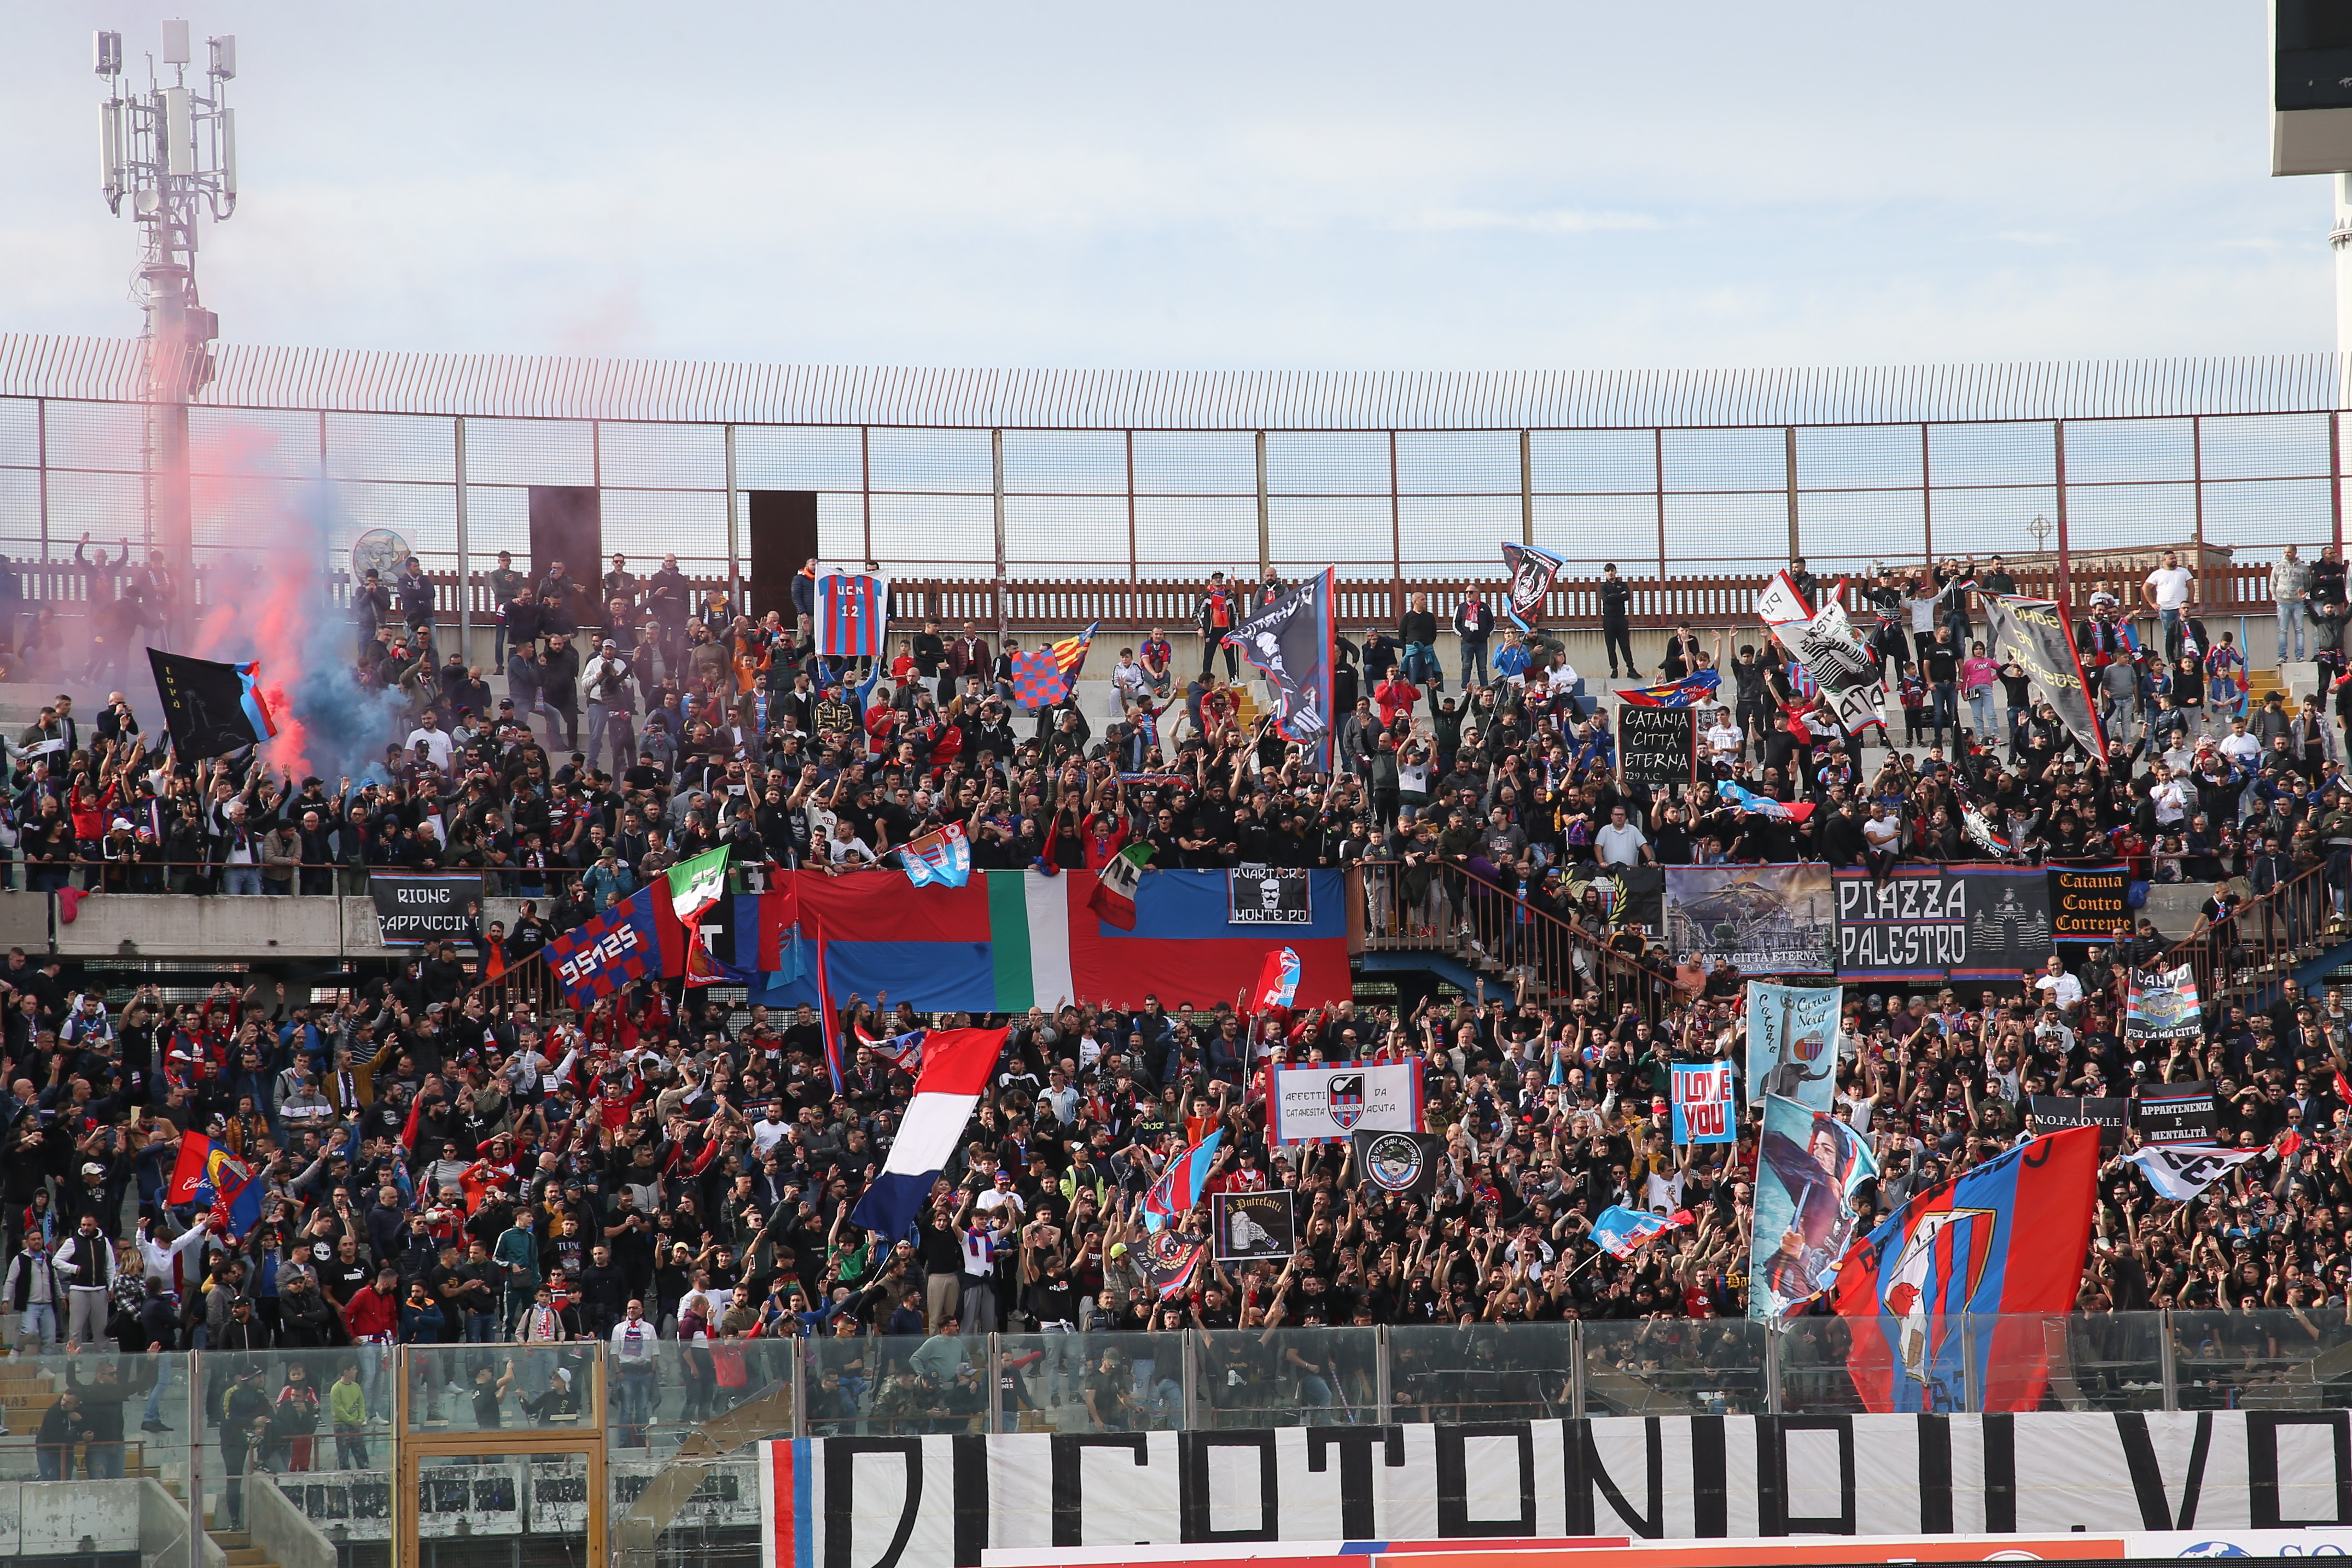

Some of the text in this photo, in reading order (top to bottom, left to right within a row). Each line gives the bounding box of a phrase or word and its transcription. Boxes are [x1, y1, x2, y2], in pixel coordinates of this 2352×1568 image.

[841, 605, 859, 617] 12
[1973, 662, 1989, 671] Cool
[1625, 710, 1689, 730] CATANIA
[1625, 753, 1689, 772] ETERNA
[1625, 772, 1640, 780] 729
[1643, 773, 1663, 781] A.C.
[1966, 800, 1999, 833] PIAZZA
[2060, 873, 2123, 888] Catania
[397, 889, 451, 904] RIONE
[1839, 878, 1966, 920] PIAZZA
[2063, 894, 2122, 911] Contro
[1235, 909, 1307, 922] MONTE PO
[2056, 914, 2132, 931] Corrente
[1841, 925, 1966, 966] PALESTRO
[558, 923, 639, 987] 95125
[1733, 950, 1769, 963] CITTÀ
[1772, 951, 1818, 962] ETERNA
[2137, 965, 2188, 987] CANTO
[1797, 992, 1832, 1013] Curva
[1759, 994, 1778, 1054] Catania
[1797, 1009, 1827, 1028] Nord
[2127, 1028, 2144, 1039] PER
[2145, 1029, 2157, 1039] LA
[1375, 1088, 1387, 1097] DA
[1673, 1068, 1732, 1105] I LOVE
[1285, 1091, 1326, 1102] AFFETTI
[1366, 1103, 1396, 1114] ACUTA
[2141, 1101, 2214, 1116] APPARTENENZA
[1682, 1101, 1726, 1136] YOU
[2034, 1114, 2123, 1127] N.O.P.A.O.V.I.E.
[2175, 1117, 2182, 1127] E
[2151, 1125, 2209, 1141] MENTALITÀ
[1373, 1138, 1418, 1158] VIA SAN JACOPO
[1225, 1196, 1284, 1215] I Putrefatti
[557, 1241, 581, 1251] TUPAC
[344, 1273, 362, 1281] PUMA
